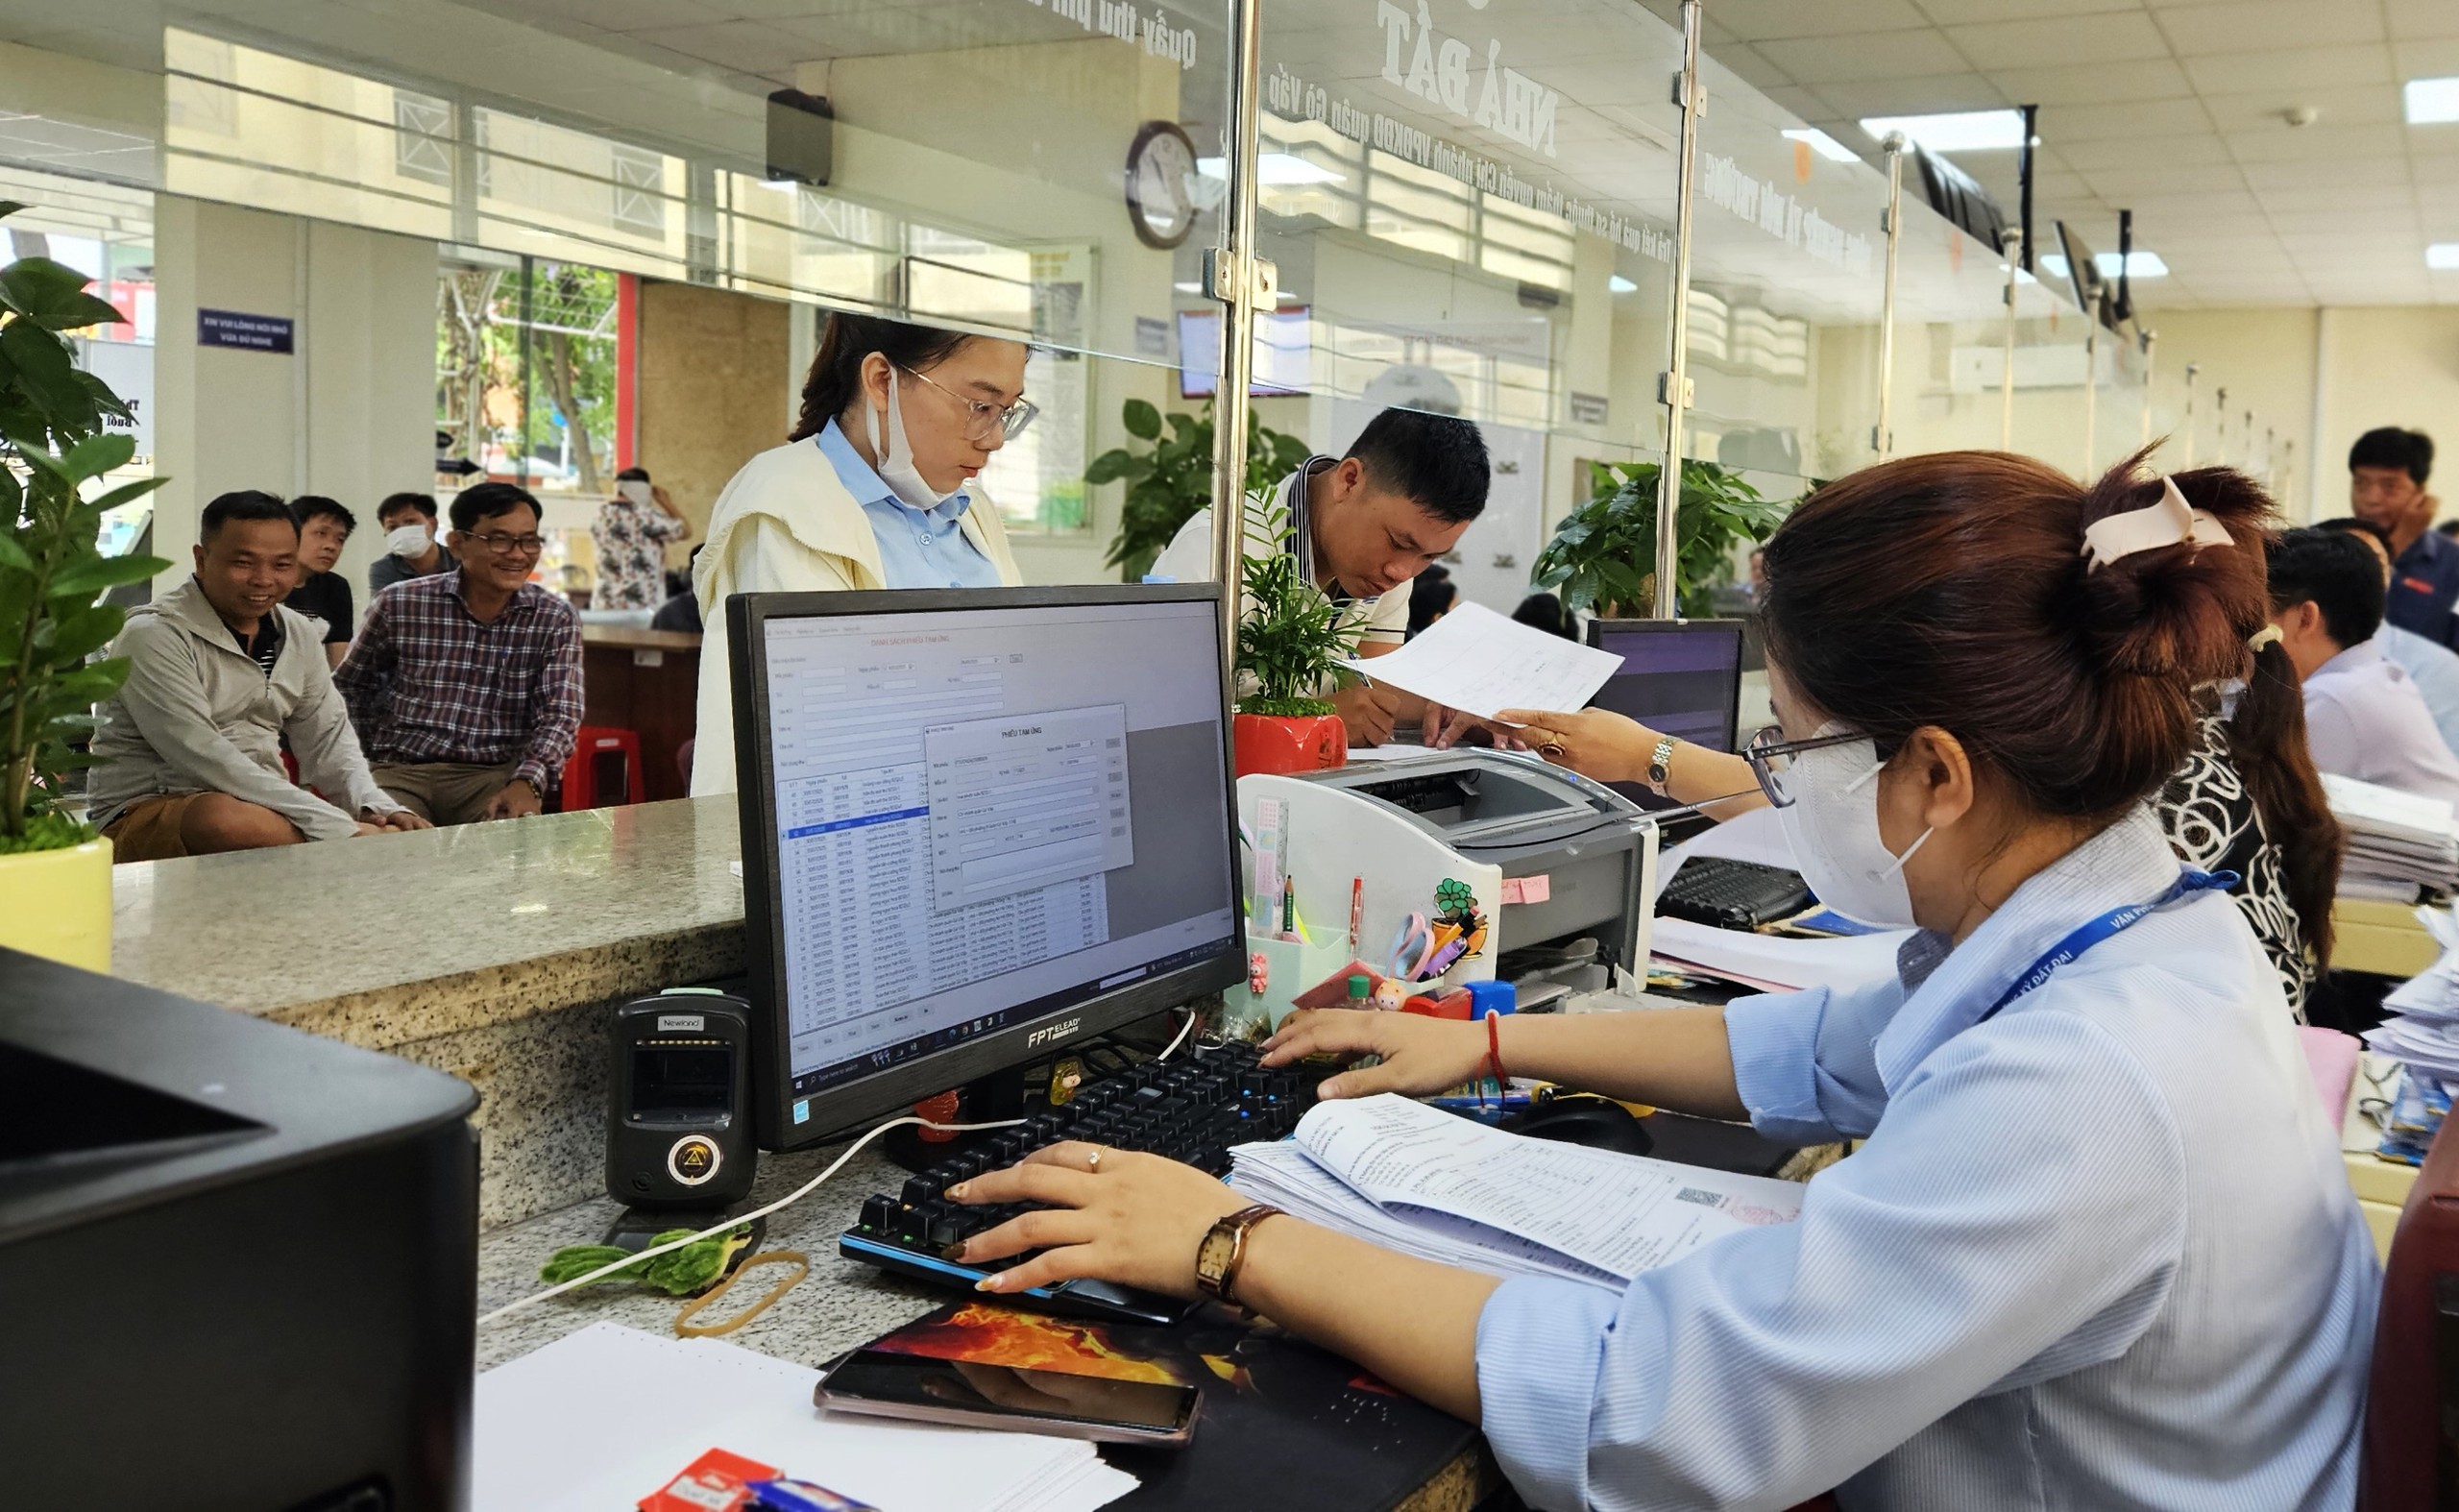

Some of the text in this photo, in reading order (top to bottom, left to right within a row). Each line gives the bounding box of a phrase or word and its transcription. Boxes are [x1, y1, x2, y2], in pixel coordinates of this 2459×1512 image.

[1001, 728, 1018, 739] PHIẾU
[2109, 903, 2155, 930] VĂN PH
[2032, 963, 2054, 987] ĐẤT
[2052, 950, 2073, 969] ĐAI
[664, 1018, 699, 1027] Newland
[1028, 1026, 1055, 1049] FPT
[1054, 1019, 1079, 1033] ELEAD
